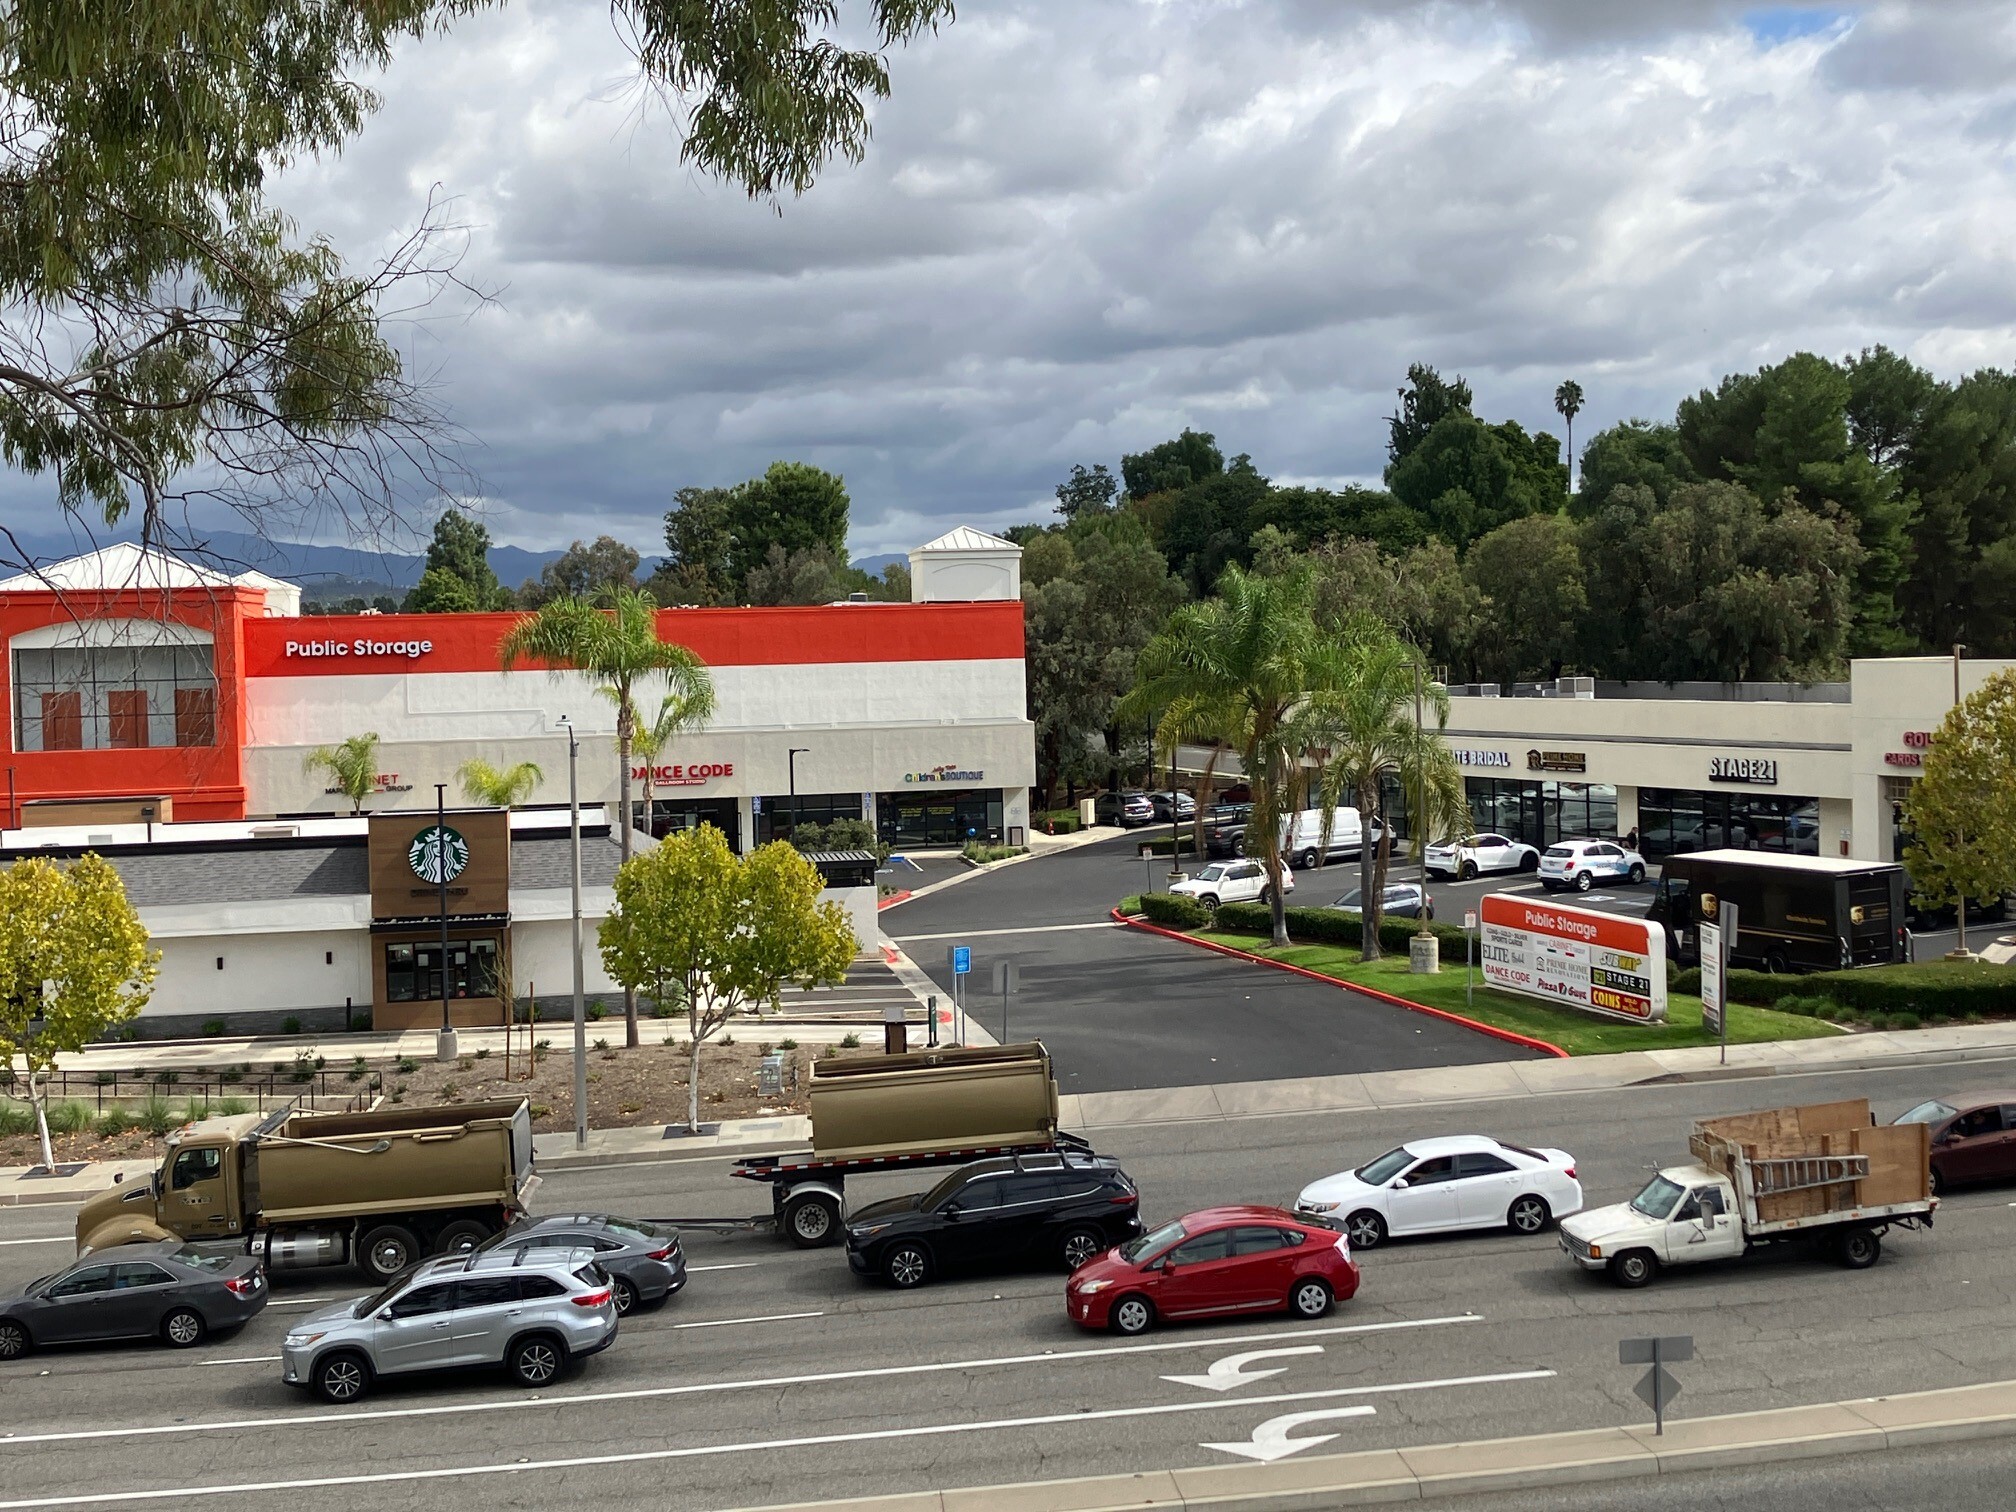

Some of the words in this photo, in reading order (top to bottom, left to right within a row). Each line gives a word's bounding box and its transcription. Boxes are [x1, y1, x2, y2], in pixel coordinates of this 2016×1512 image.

[285, 640, 349, 657] Public
[353, 638, 433, 658] Storage
[1468, 750, 1509, 767] BRIDAL
[1710, 757, 1776, 779] STAGE21
[1884, 752, 1921, 767] CARDS
[688, 763, 734, 778] CODE
[945, 770, 984, 781] BOUTIQUE
[385, 784, 413, 793] GROUP
[1525, 910, 1555, 929] Public
[1557, 916, 1597, 939] Storage
[1482, 943, 1509, 963] ELITE
[1600, 952, 1641, 972] SUBWAY
[1485, 964, 1509, 977] DANCE
[1510, 970, 1530, 983] CODE
[1606, 972, 1635, 987] STAGE
[1638, 979, 1649, 990] 21
[1537, 978, 1557, 992] Pizza
[1568, 986, 1587, 999] Guys
[1593, 990, 1621, 1009] COINS
